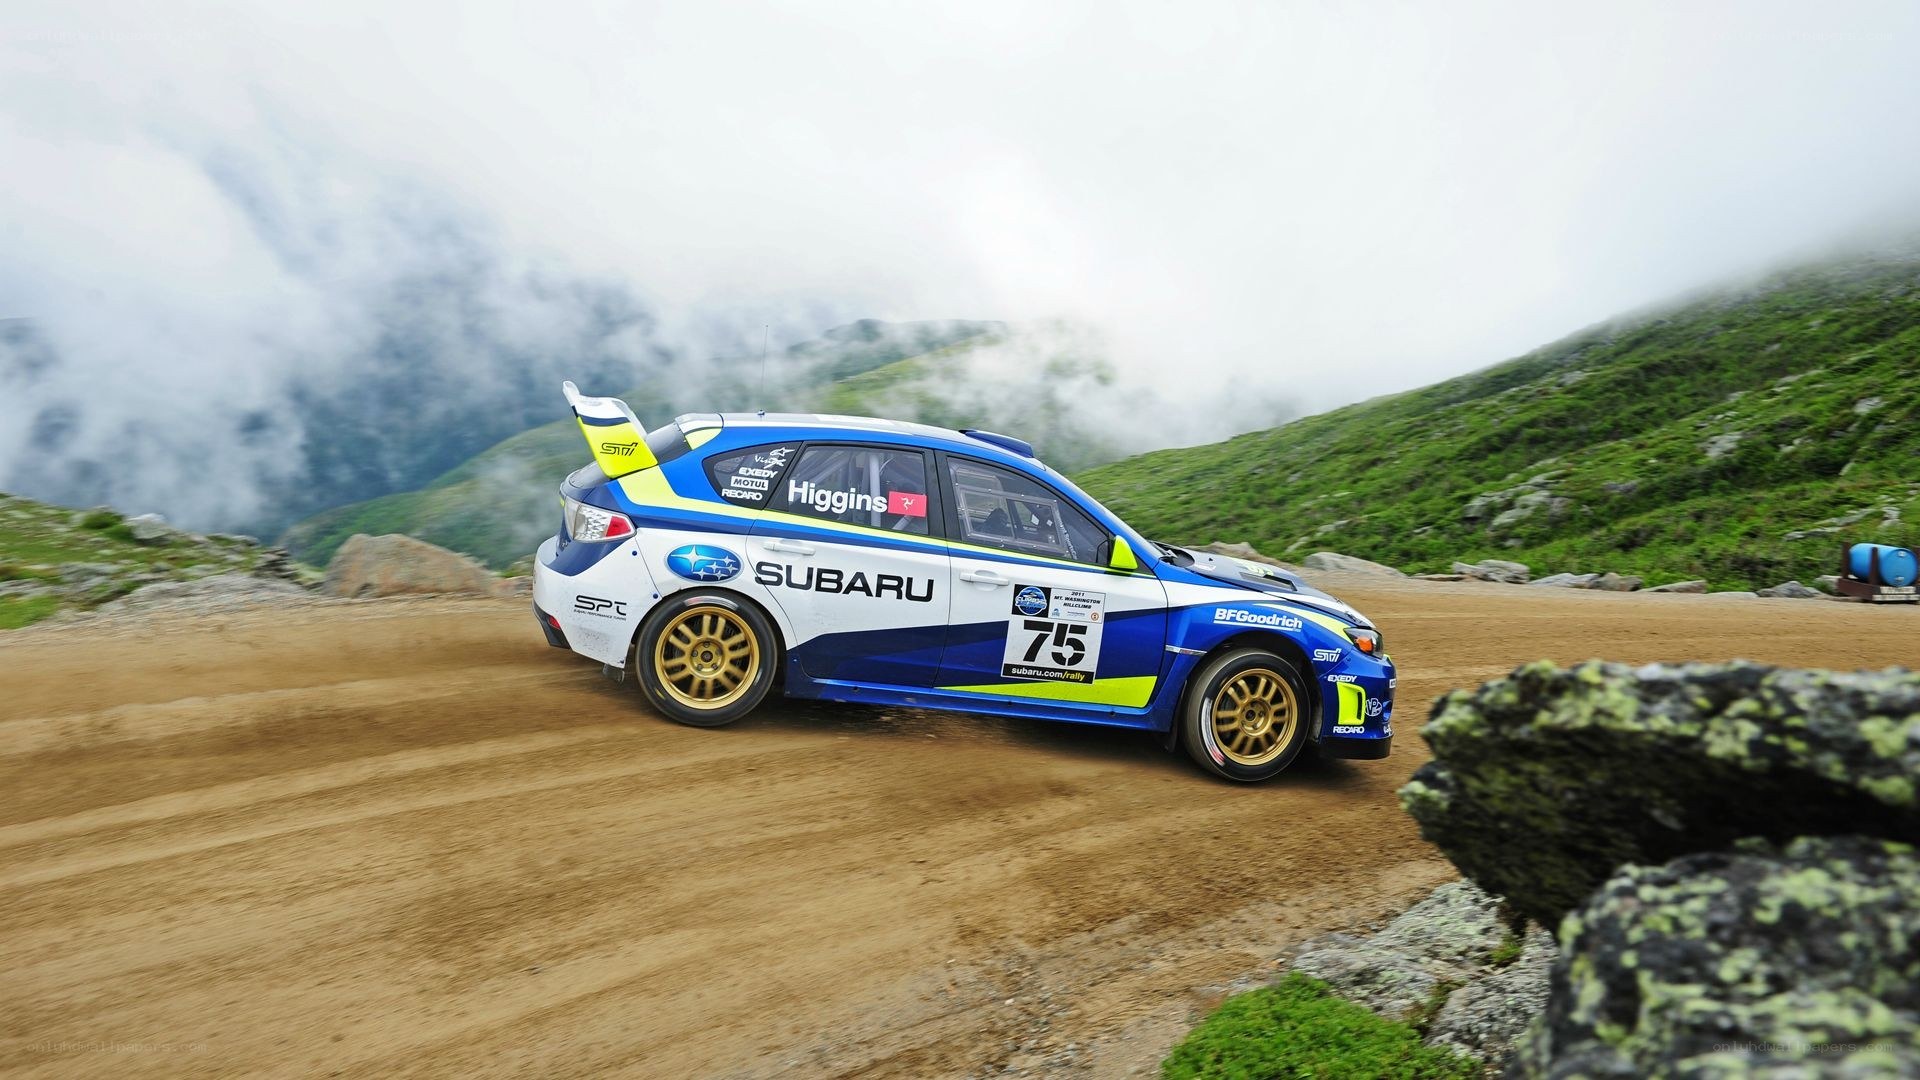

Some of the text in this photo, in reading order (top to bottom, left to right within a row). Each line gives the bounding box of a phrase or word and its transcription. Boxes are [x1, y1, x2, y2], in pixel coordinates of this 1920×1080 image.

[739, 467, 778, 478] EXEDY
[733, 478, 766, 489] MOTUL
[722, 488, 763, 500] RECARO
[788, 480, 888, 514] Higgins
[755, 561, 934, 602] SUBARU
[1064, 596, 1101, 604] WASHINGTON
[1214, 608, 1303, 629] BFGoodrich
[1023, 620, 1088, 666] 75
[1012, 667, 1085, 681] subaru.com/rally
[1333, 726, 1365, 734] RECARO
